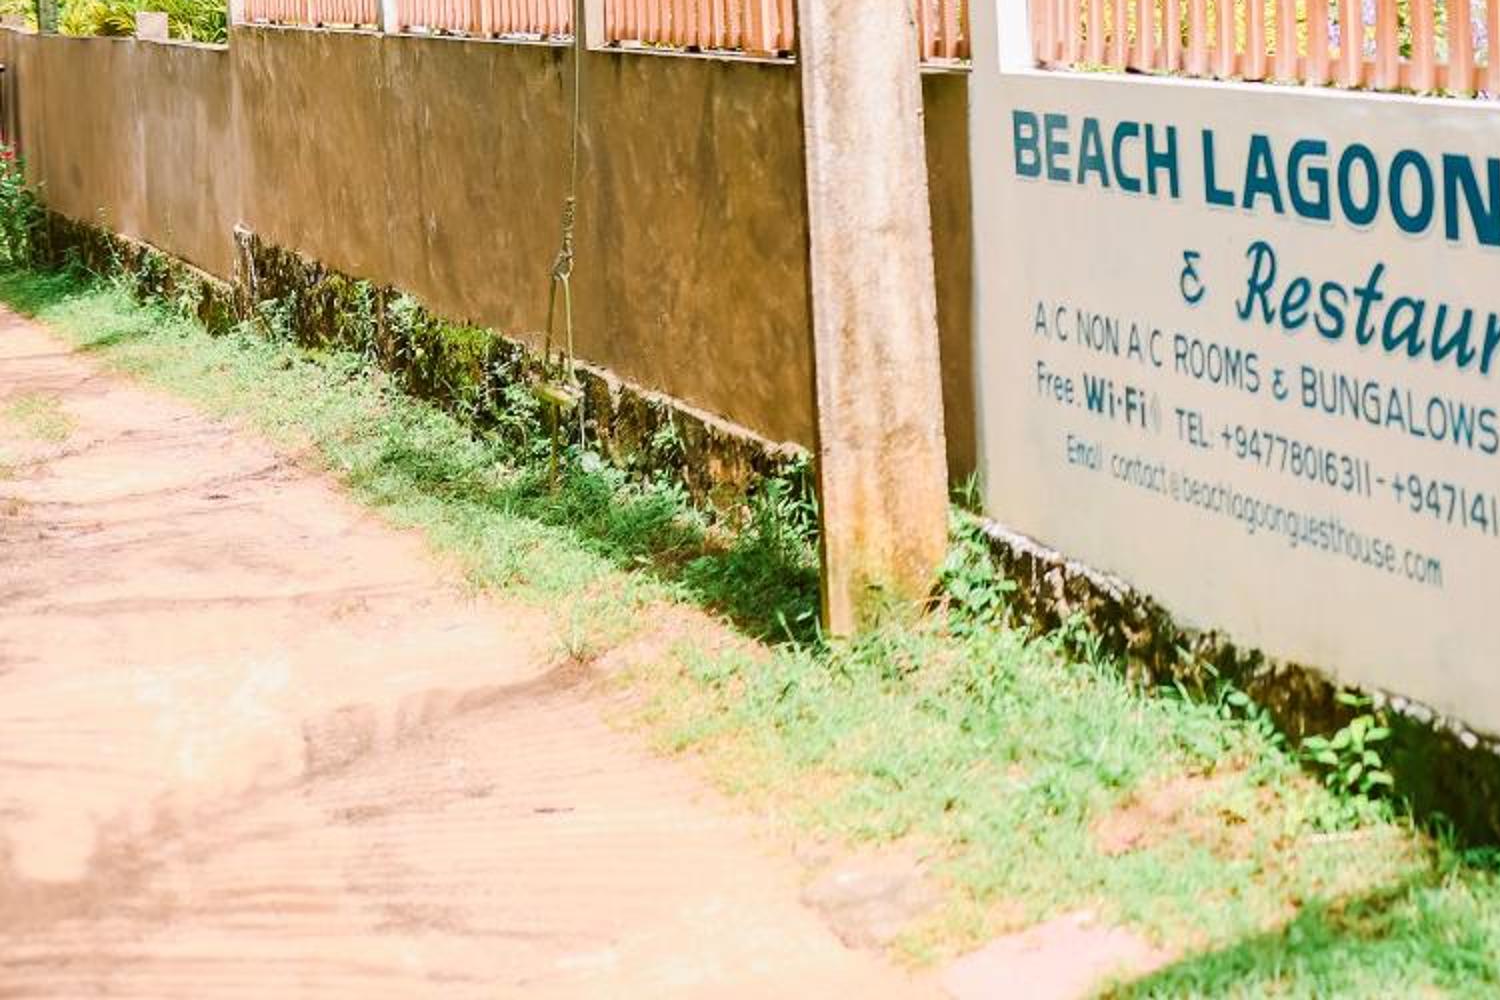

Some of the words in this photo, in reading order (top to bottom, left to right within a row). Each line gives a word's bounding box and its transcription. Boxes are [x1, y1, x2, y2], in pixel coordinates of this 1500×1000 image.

[1012, 109, 1180, 199] BEACH
[1179, 249, 1206, 305] &
[1076, 309, 1120, 357] NON
[1173, 333, 1261, 394] ROOMS
[1271, 368, 1289, 402] &
[1300, 364, 1500, 456] BUNGALOWS
